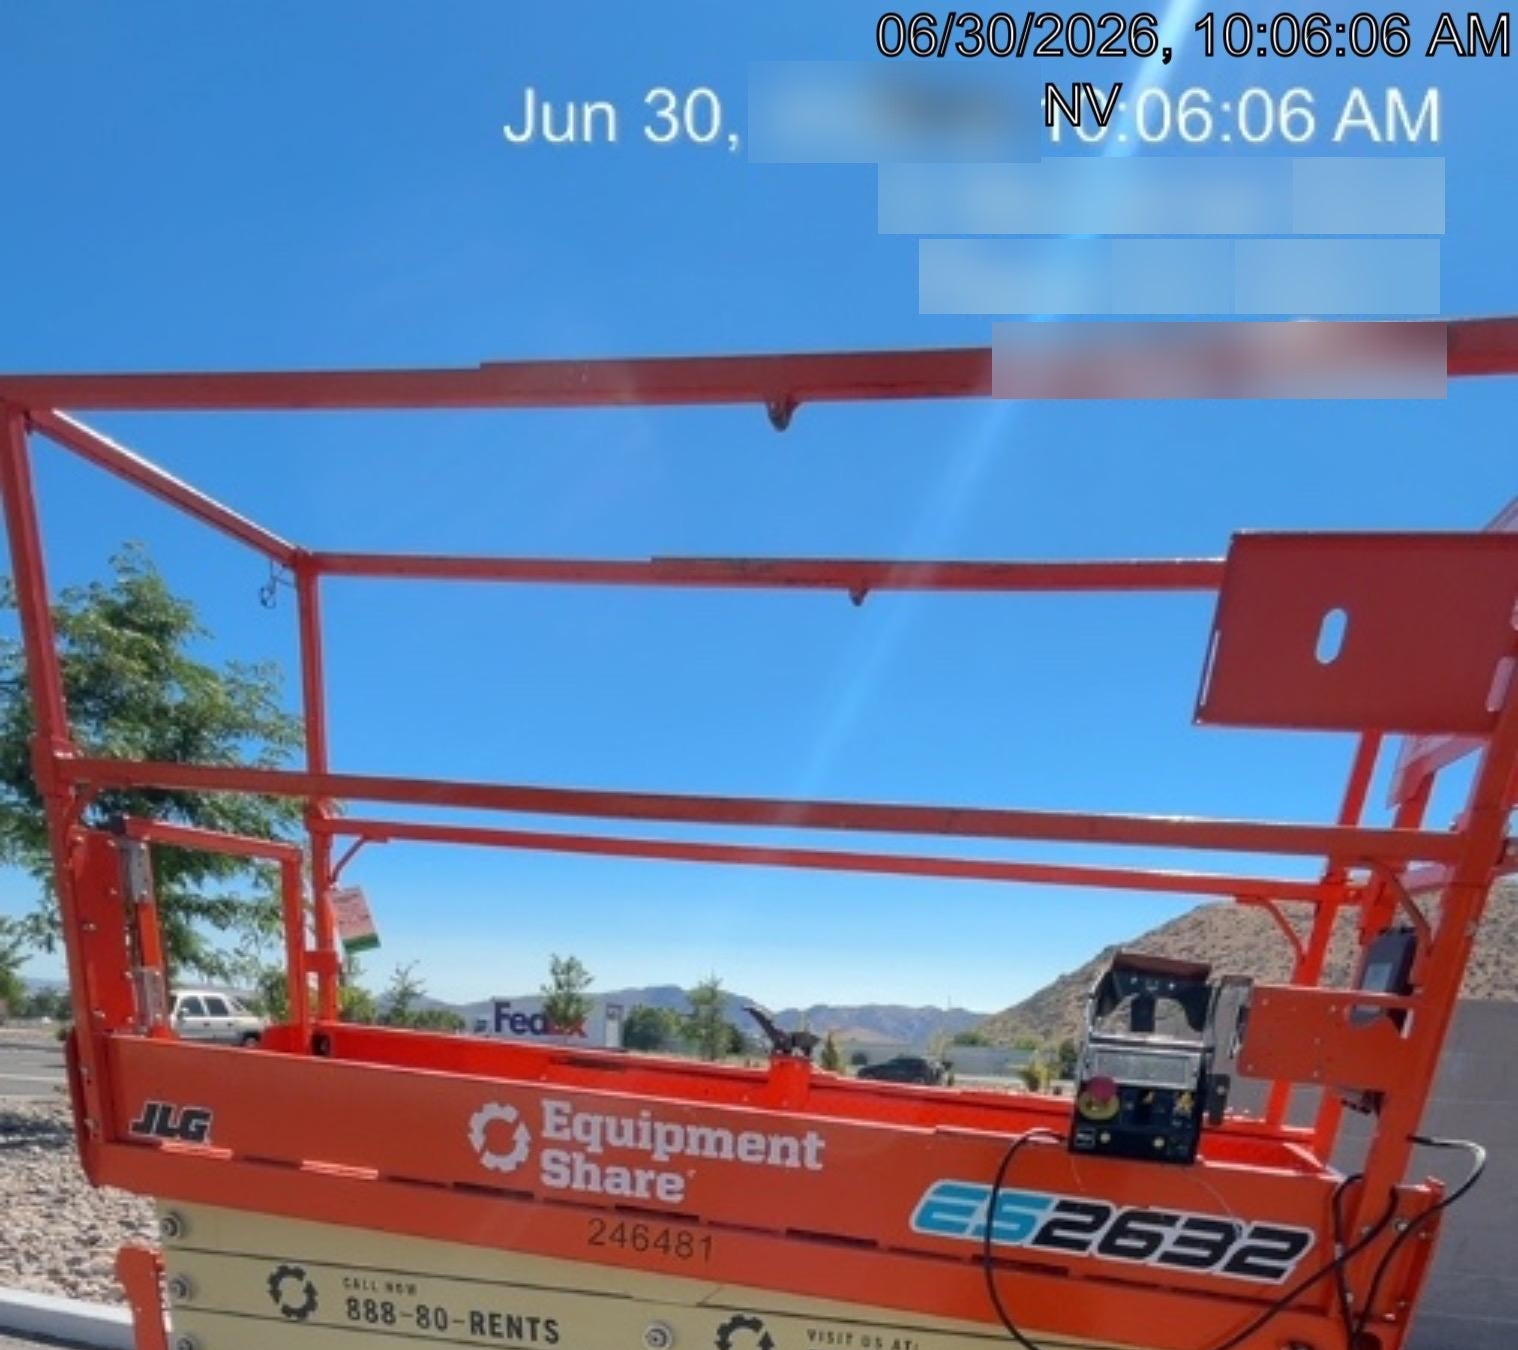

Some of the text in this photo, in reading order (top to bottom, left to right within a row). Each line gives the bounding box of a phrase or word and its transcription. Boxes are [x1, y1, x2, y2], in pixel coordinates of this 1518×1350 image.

[493, 1002, 588, 1038] Fedx
[130, 1101, 213, 1145] JLG
[541, 1099, 826, 1170] Equipment
[540, 1149, 686, 1204] Share
[587, 1217, 714, 1262] 246481
[910, 1179, 1313, 1285] ES2632
[343, 1277, 417, 1296] CALL NOW
[346, 1297, 560, 1345] 888-80-RENTS
[807, 1328, 853, 1347] VISIT
[861, 1335, 883, 1349] US
